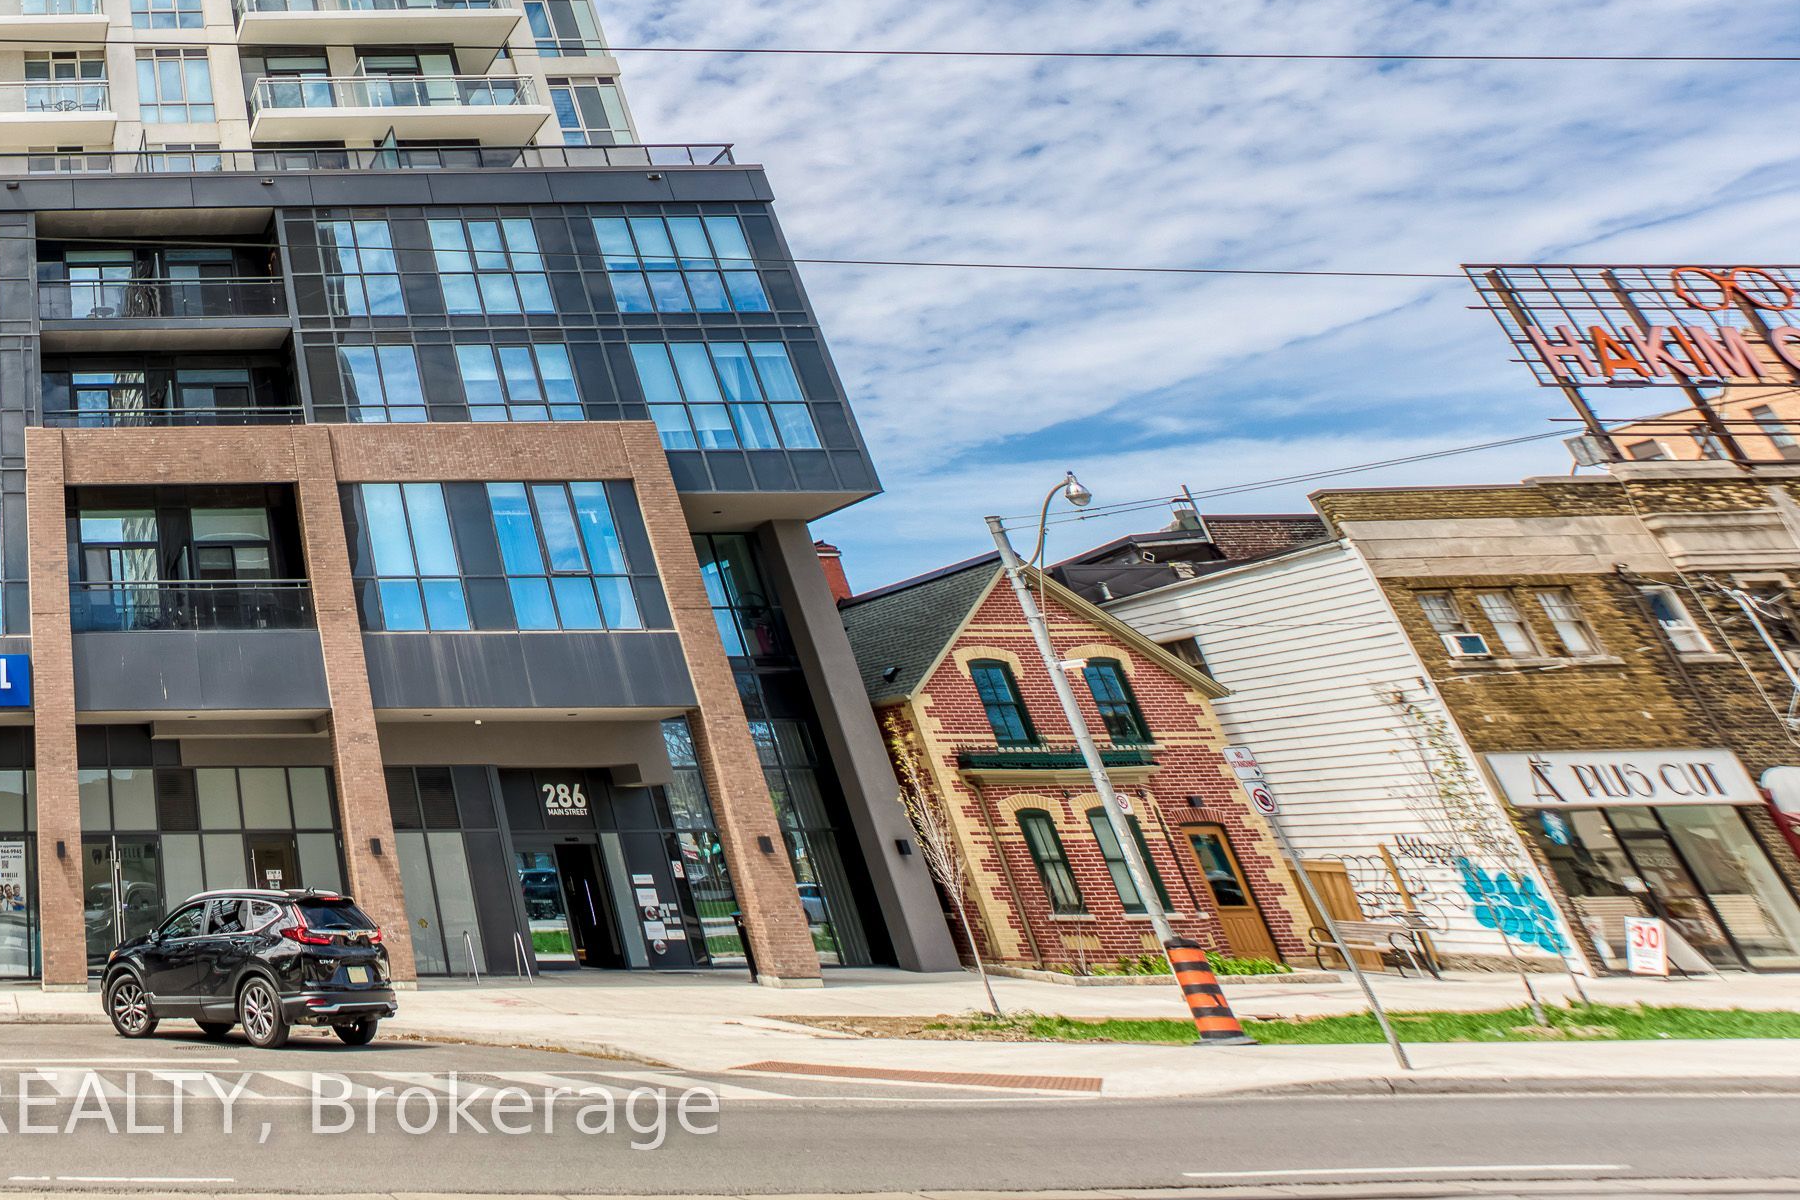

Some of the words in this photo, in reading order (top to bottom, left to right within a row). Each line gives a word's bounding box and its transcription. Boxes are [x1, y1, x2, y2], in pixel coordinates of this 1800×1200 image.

[1524, 325, 1768, 377] HAKIM
[1569, 762, 1655, 798] PLUS
[1658, 762, 1728, 797] CUT
[542, 783, 586, 808] 286
[547, 808, 564, 816] MAIN
[1630, 926, 1659, 948] 30
